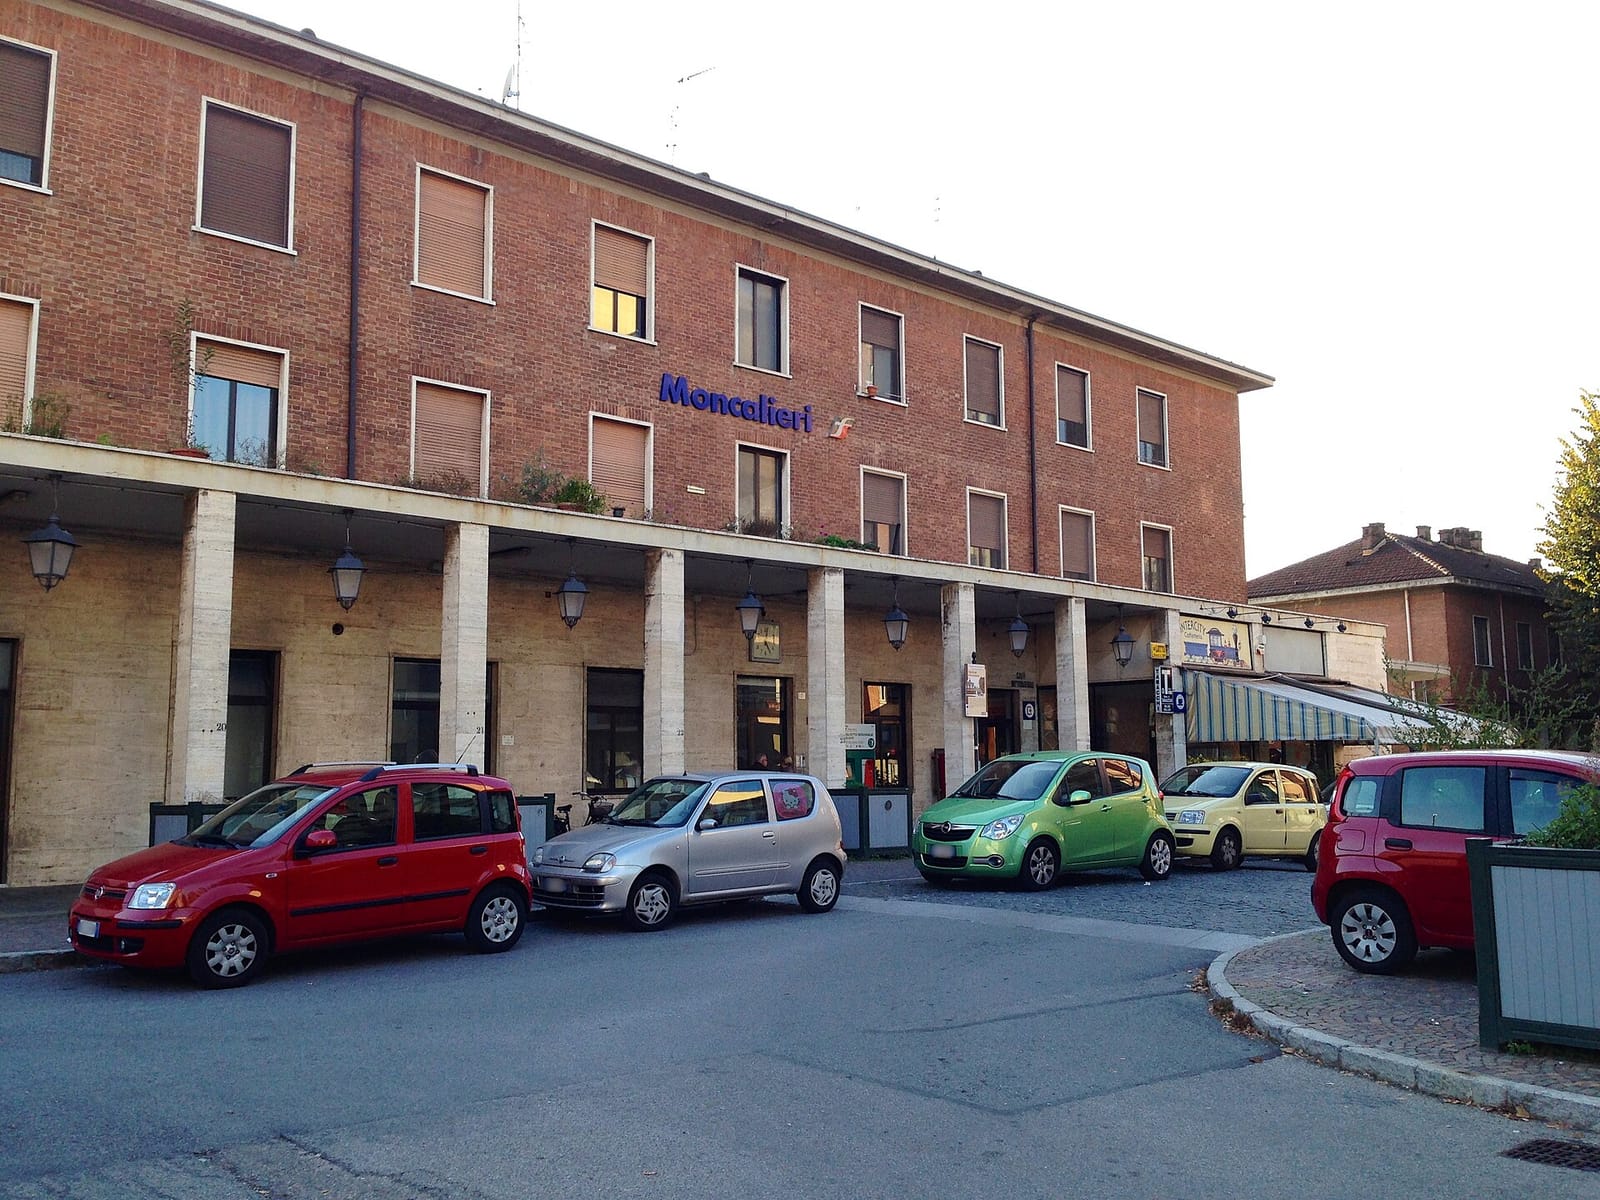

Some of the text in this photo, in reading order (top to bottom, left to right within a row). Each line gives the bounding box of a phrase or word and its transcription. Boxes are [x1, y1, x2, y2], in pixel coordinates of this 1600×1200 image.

[659, 372, 813, 433] Moncalieri
[216, 722, 227, 731] 20
[476, 726, 484, 734] 21
